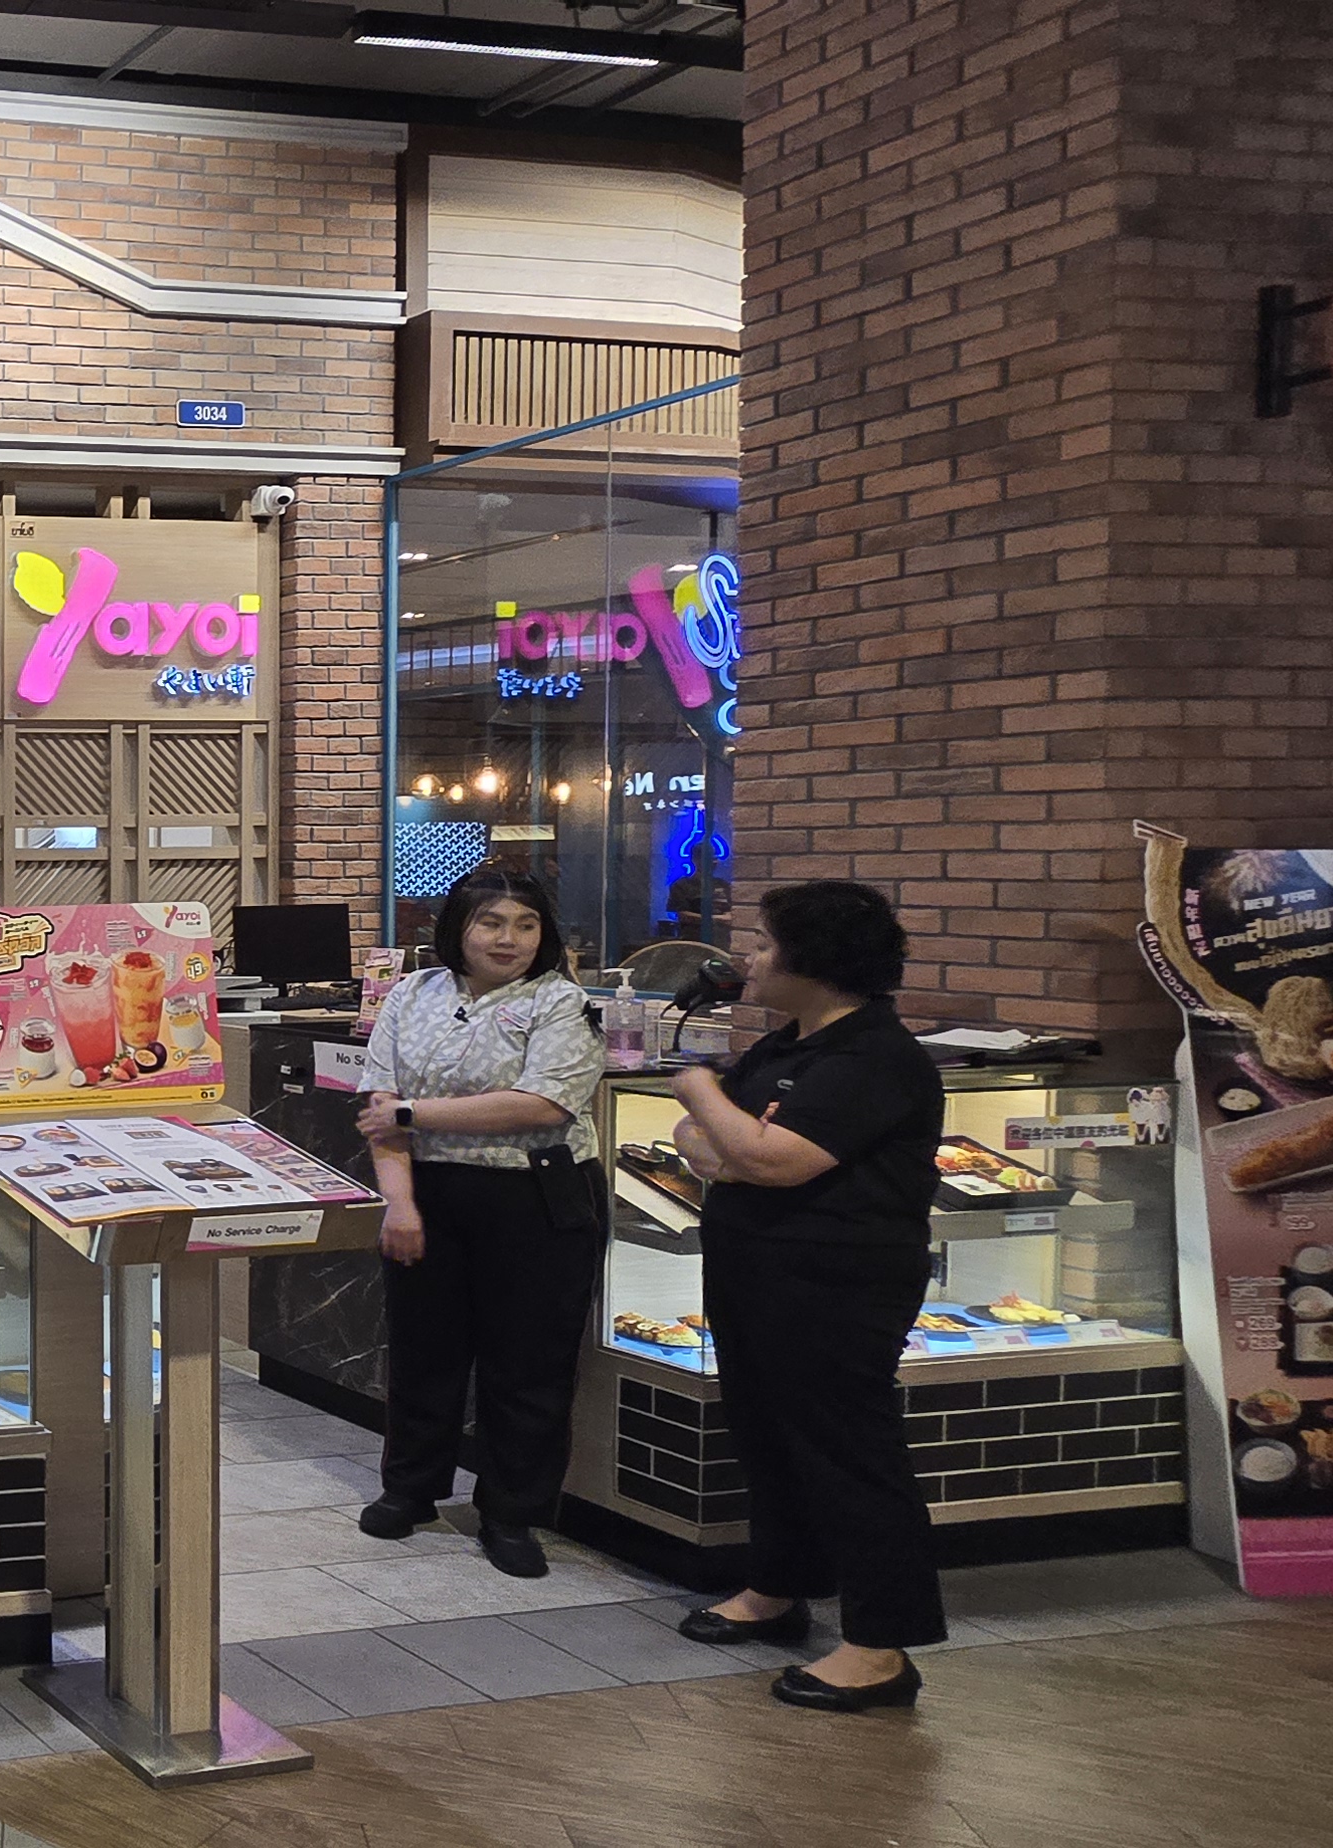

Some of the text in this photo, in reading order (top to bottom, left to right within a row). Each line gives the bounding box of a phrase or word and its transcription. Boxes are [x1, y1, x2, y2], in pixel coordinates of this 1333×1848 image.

[193, 405, 228, 421] 3034
[12, 546, 261, 704] Yayoi
[336, 1052, 351, 1065] No
[206, 1224, 302, 1239] No Service Charge
